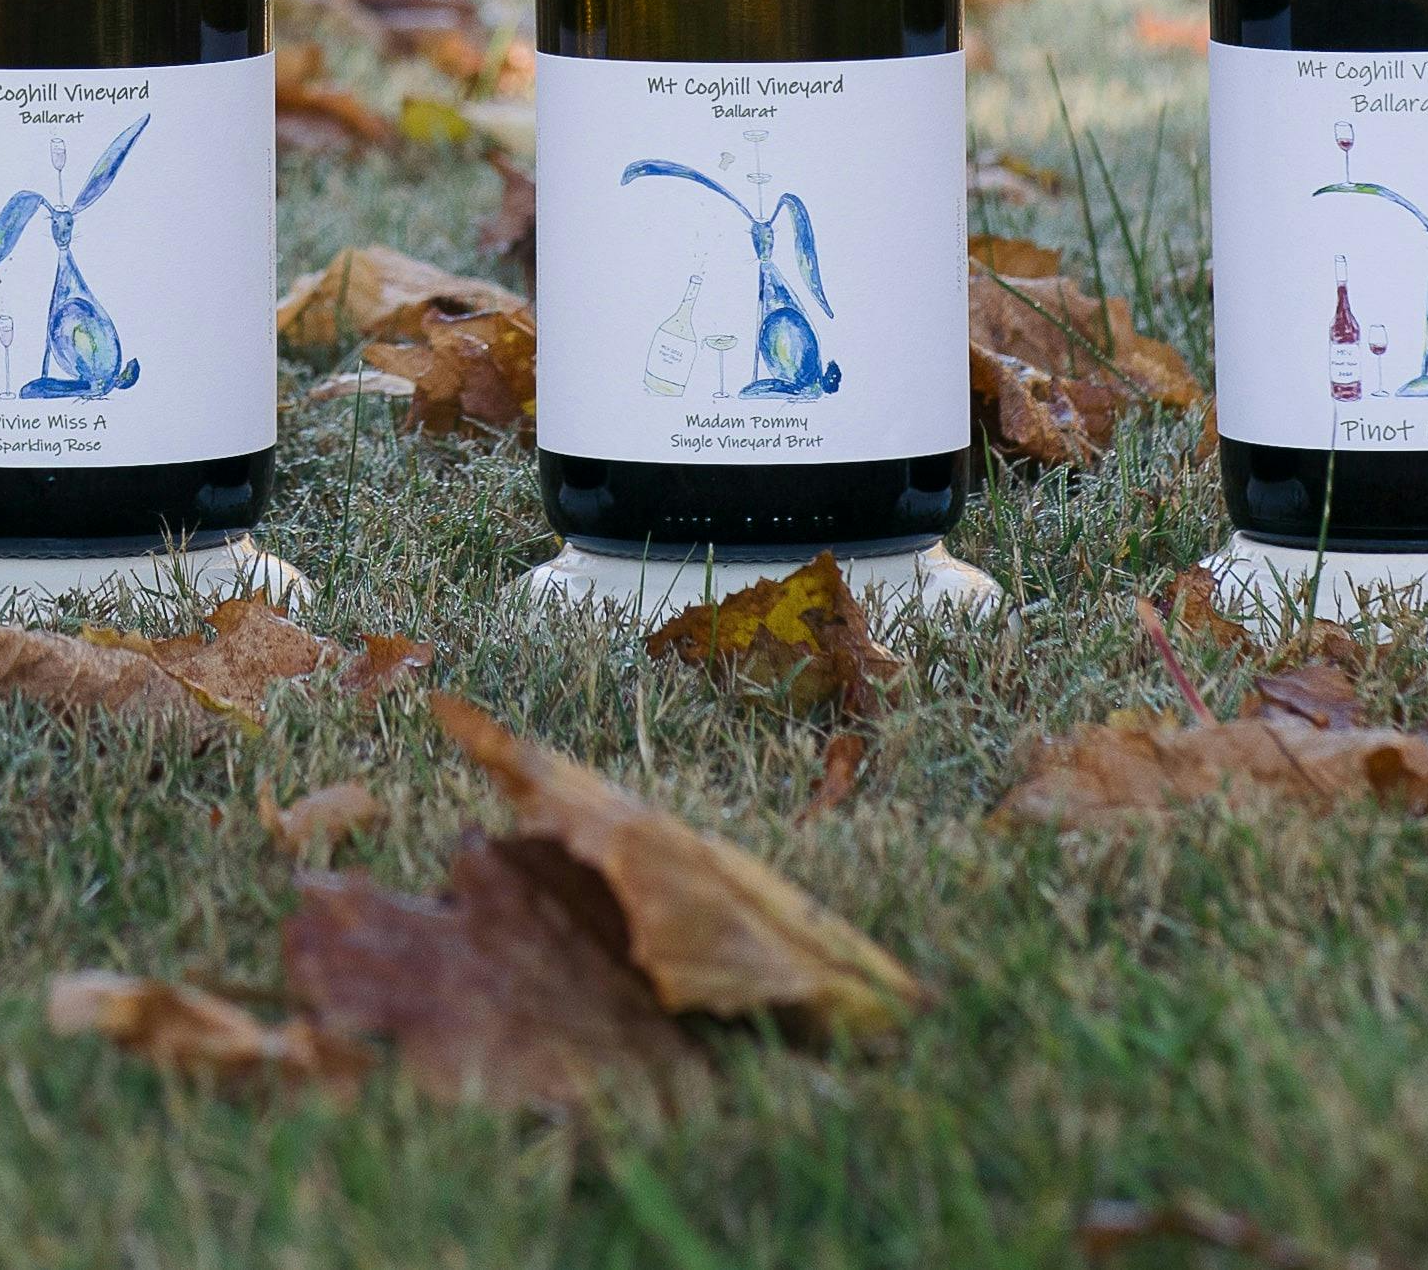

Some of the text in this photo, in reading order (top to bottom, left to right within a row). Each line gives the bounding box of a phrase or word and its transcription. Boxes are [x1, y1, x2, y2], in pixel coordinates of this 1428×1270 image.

[1297, 59, 1327, 79] Mt
[1335, 59, 1405, 87] Coghill
[63, 79, 150, 105] Vineyard
[647, 73, 844, 103] Mt Coghill Vineyard
[18, 109, 85, 125] Ballarat
[711, 103, 778, 119] Ballarat
[47, 413, 88, 430] Miss
[92, 414, 107, 431] A
[685, 412, 809, 432] Madam Pommy
[1339, 417, 1415, 442] Pinot
[63, 438, 102, 453] Rose
[670, 433, 824, 453] Single Vineyard Brut
